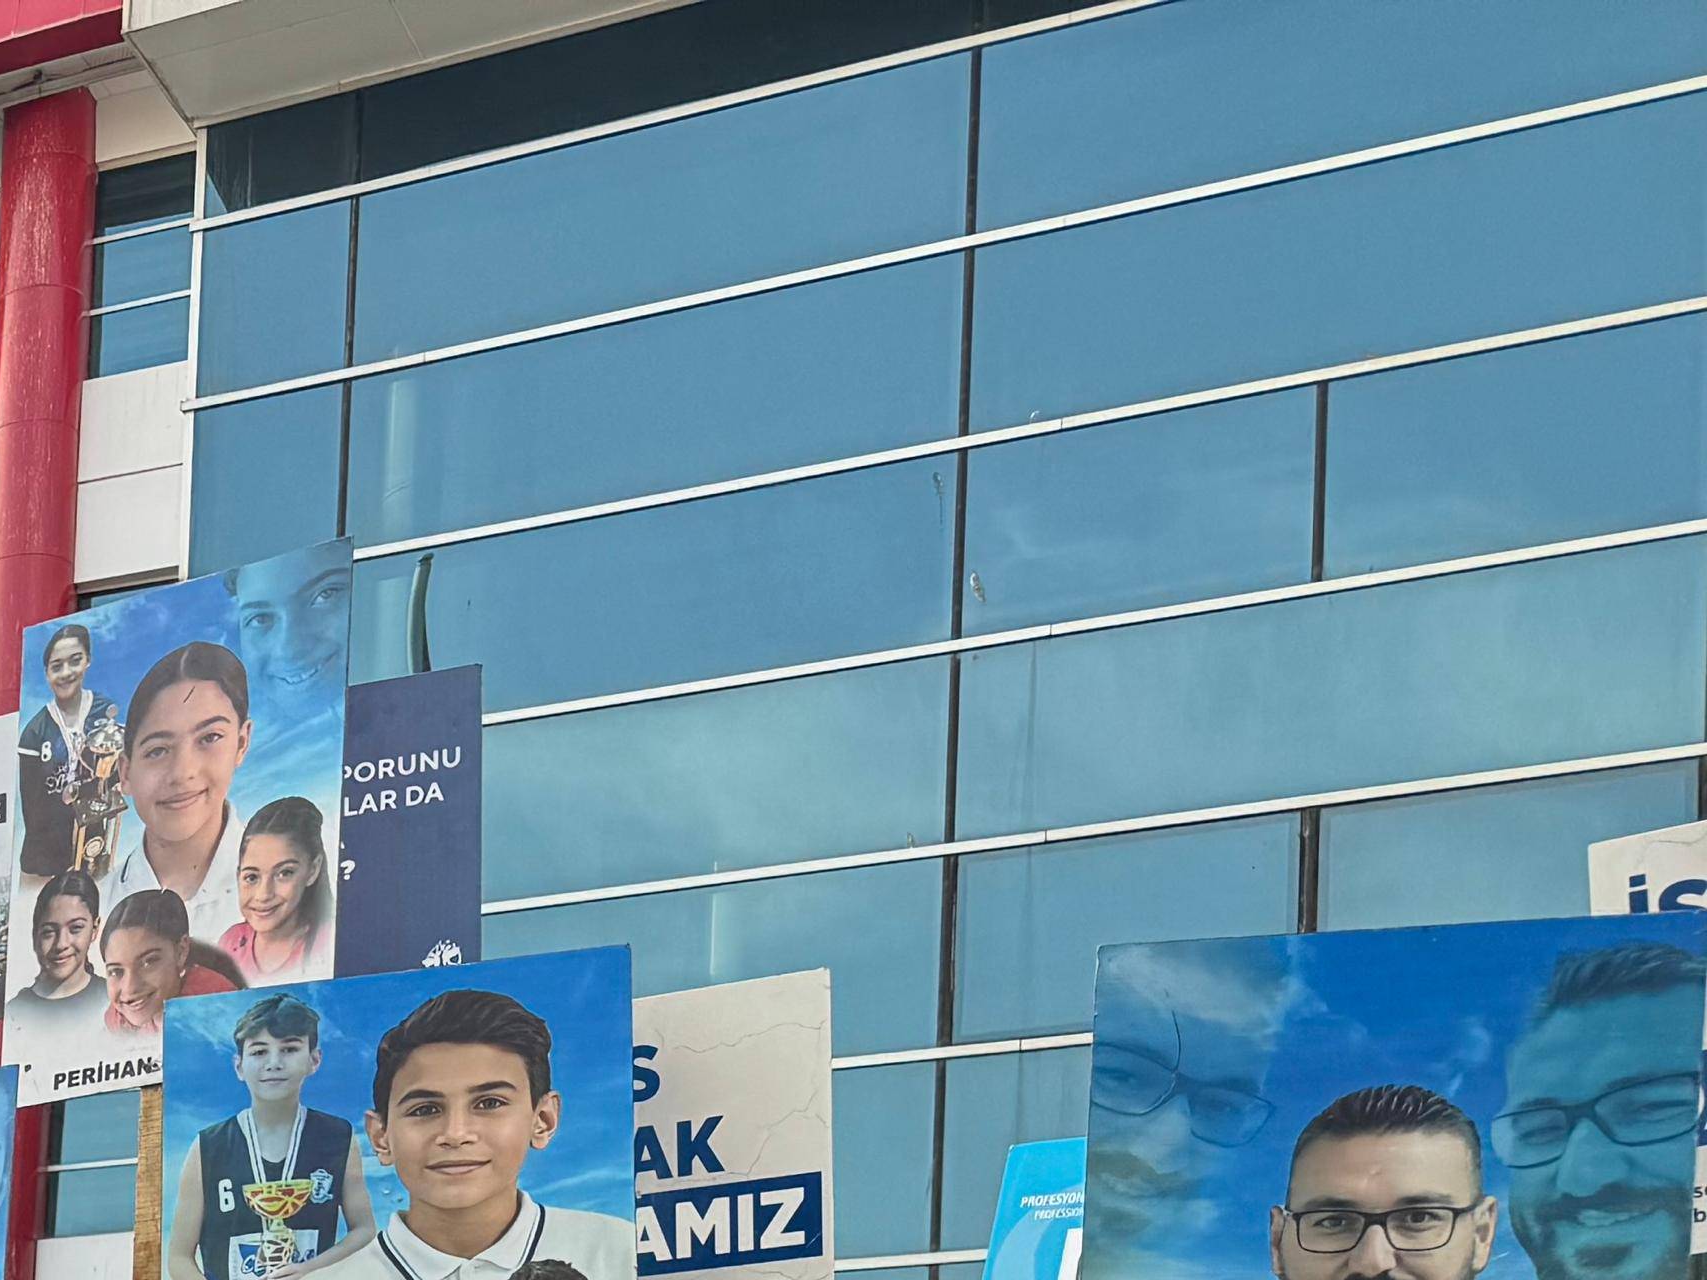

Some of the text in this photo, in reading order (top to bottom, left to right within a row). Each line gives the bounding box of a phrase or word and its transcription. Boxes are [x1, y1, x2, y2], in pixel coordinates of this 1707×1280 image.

[405, 784, 444, 808] DA
[53, 1056, 153, 1090] PERİHAN
[218, 1179, 236, 1213] 6
